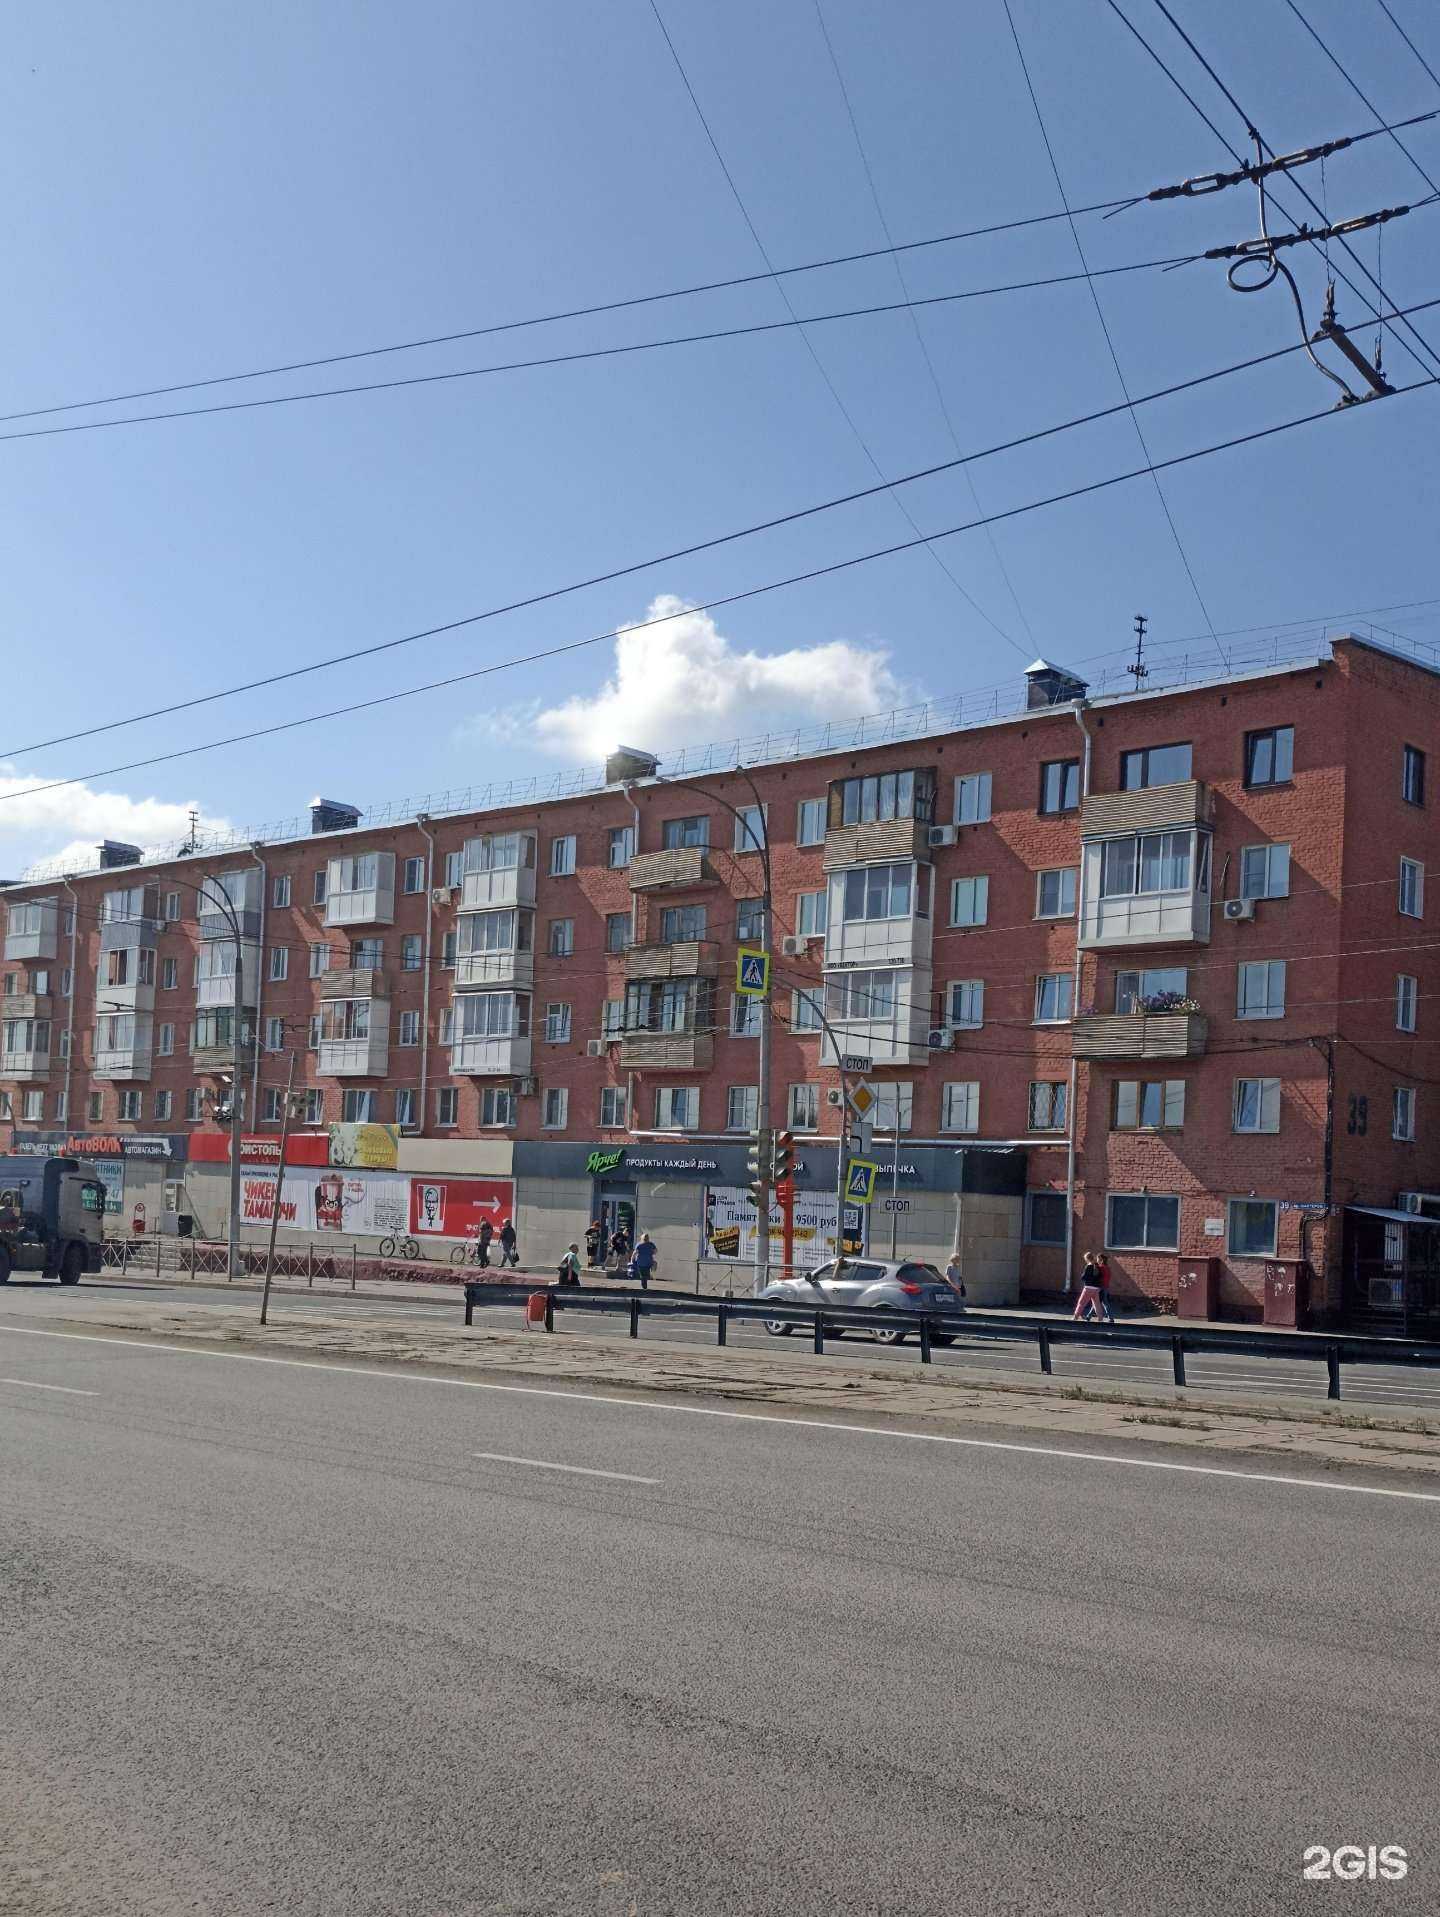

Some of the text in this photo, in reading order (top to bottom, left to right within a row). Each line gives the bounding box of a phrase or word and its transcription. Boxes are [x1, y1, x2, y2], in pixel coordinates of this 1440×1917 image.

[846, 1057, 869, 1071] СТОП
[1347, 1094, 1369, 1136] 39
[124, 1145, 162, 1154] АВТОМАГАЗИН
[240, 1143, 281, 1156] ИСТОЛЬ
[586, 1148, 624, 1172] Ярче!
[626, 1158, 717, 1170] ПРОДУКТЫ КАЖДЫЙ ДЕНЬ
[875, 1164, 916, 1174] ВЫПЧКА
[244, 1180, 278, 1200] ЧИКЕН
[244, 1198, 297, 1221] ТАМАГЧИ
[885, 1200, 910, 1212] СТОП
[1280, 1201, 1290, 1209] 39
[727, 1210, 781, 1224] Памятки
[796, 1213, 817, 1225] 9500
